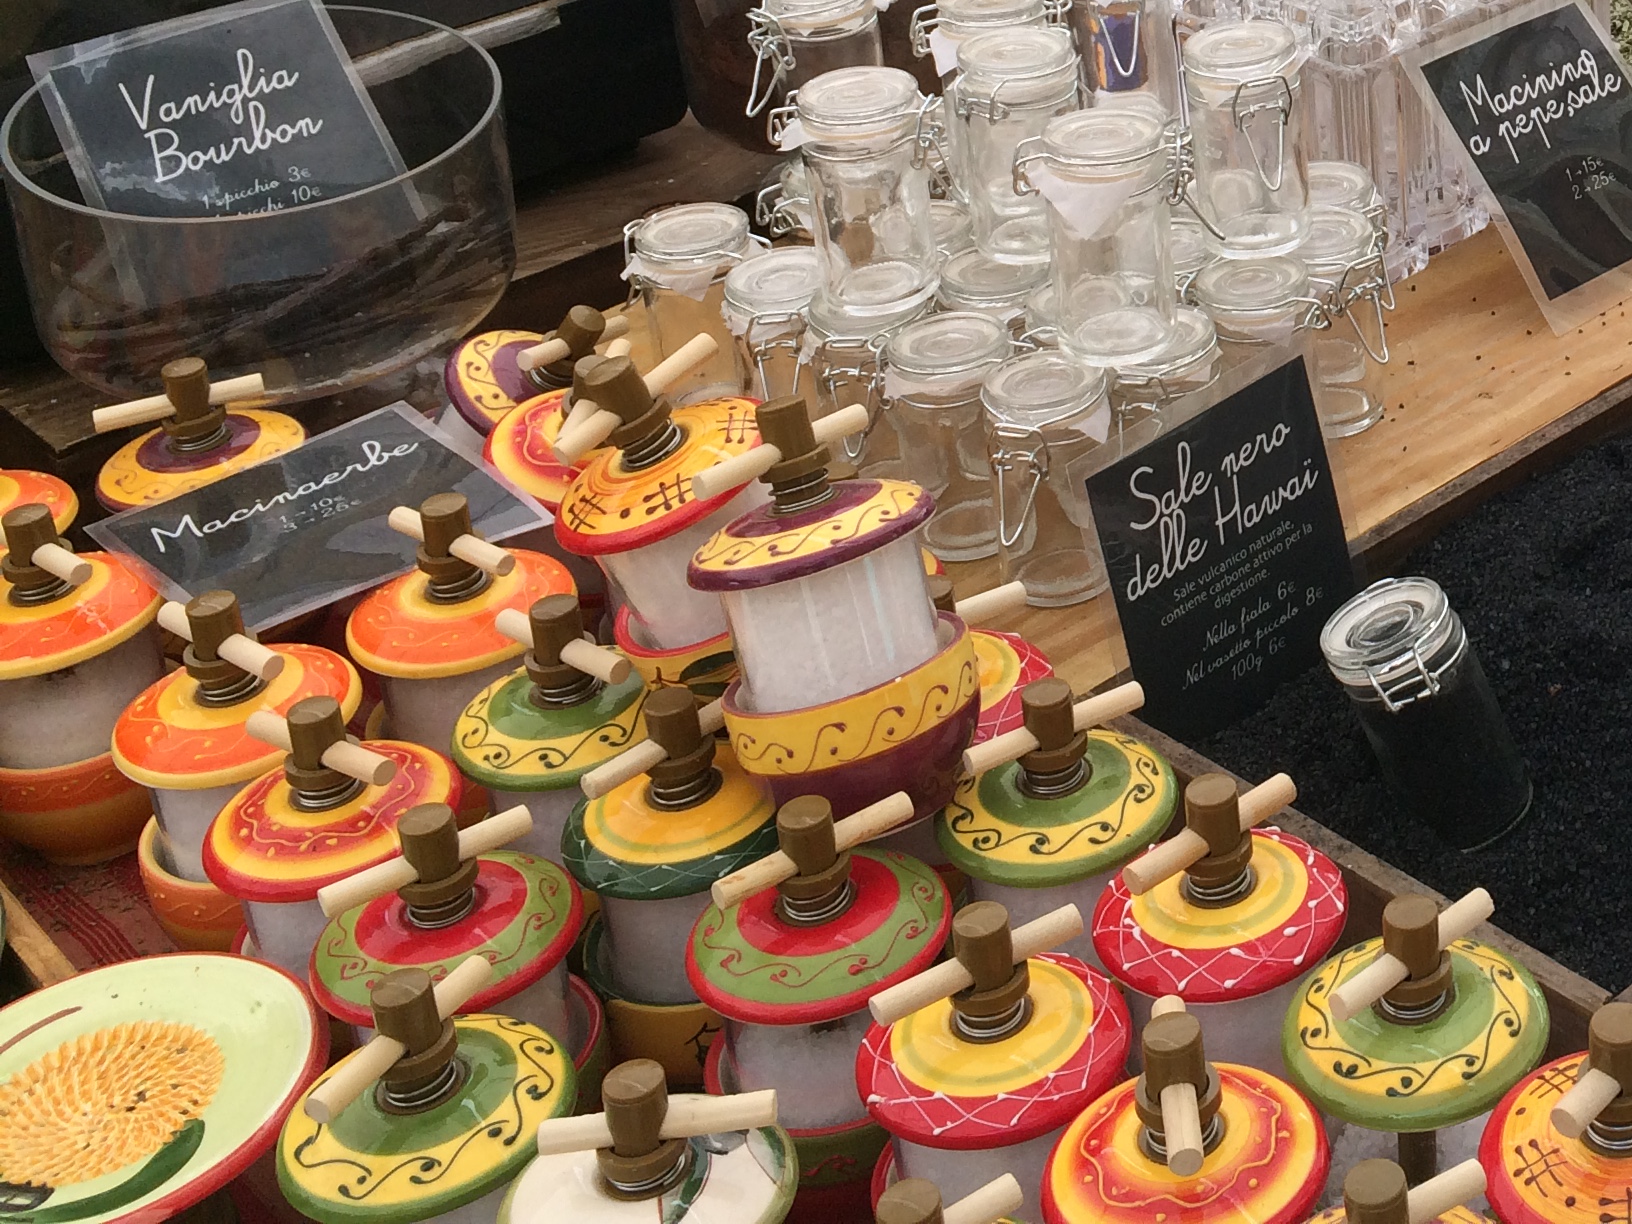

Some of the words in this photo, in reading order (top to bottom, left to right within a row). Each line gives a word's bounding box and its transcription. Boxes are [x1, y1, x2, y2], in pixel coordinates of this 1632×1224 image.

[117, 47, 300, 132] Vaniglia
[1459, 48, 1599, 126] Macinino
[143, 99, 325, 184] Bourbon
[1468, 133, 1492, 157] a
[1581, 156, 1606, 175] 15€
[214, 176, 283, 210] spicchio
[287, 165, 313, 184] 3€
[290, 184, 323, 205] 10€
[1592, 171, 1618, 192] 25€
[150, 438, 420, 554] Macinaerbe
[310, 494, 347, 512] 10€
[1129, 440, 1213, 531] Sale
[1220, 422, 1292, 478] nero
[1126, 508, 1209, 602] delle
[1160, 592, 1209, 628] contiene
[1208, 565, 1253, 602] carbone
[1252, 544, 1285, 573] attivo
[1284, 535, 1303, 556] per
[1173, 581, 1198, 603] Sale
[1196, 552, 1249, 589] vulcanico
[1248, 520, 1296, 556] naturale,
[1213, 570, 1272, 610] digestione.
[1181, 666, 1208, 691] Nel
[1206, 637, 1253, 673] vasetto
[1254, 605, 1301, 649] piccolo
[1304, 585, 1326, 607] 8€
[1202, 621, 1238, 652] Nella
[1239, 599, 1273, 633] fiala
[1276, 579, 1297, 600] 6€
[1229, 652, 1265, 681] 100g
[1267, 634, 1289, 657] 6€
